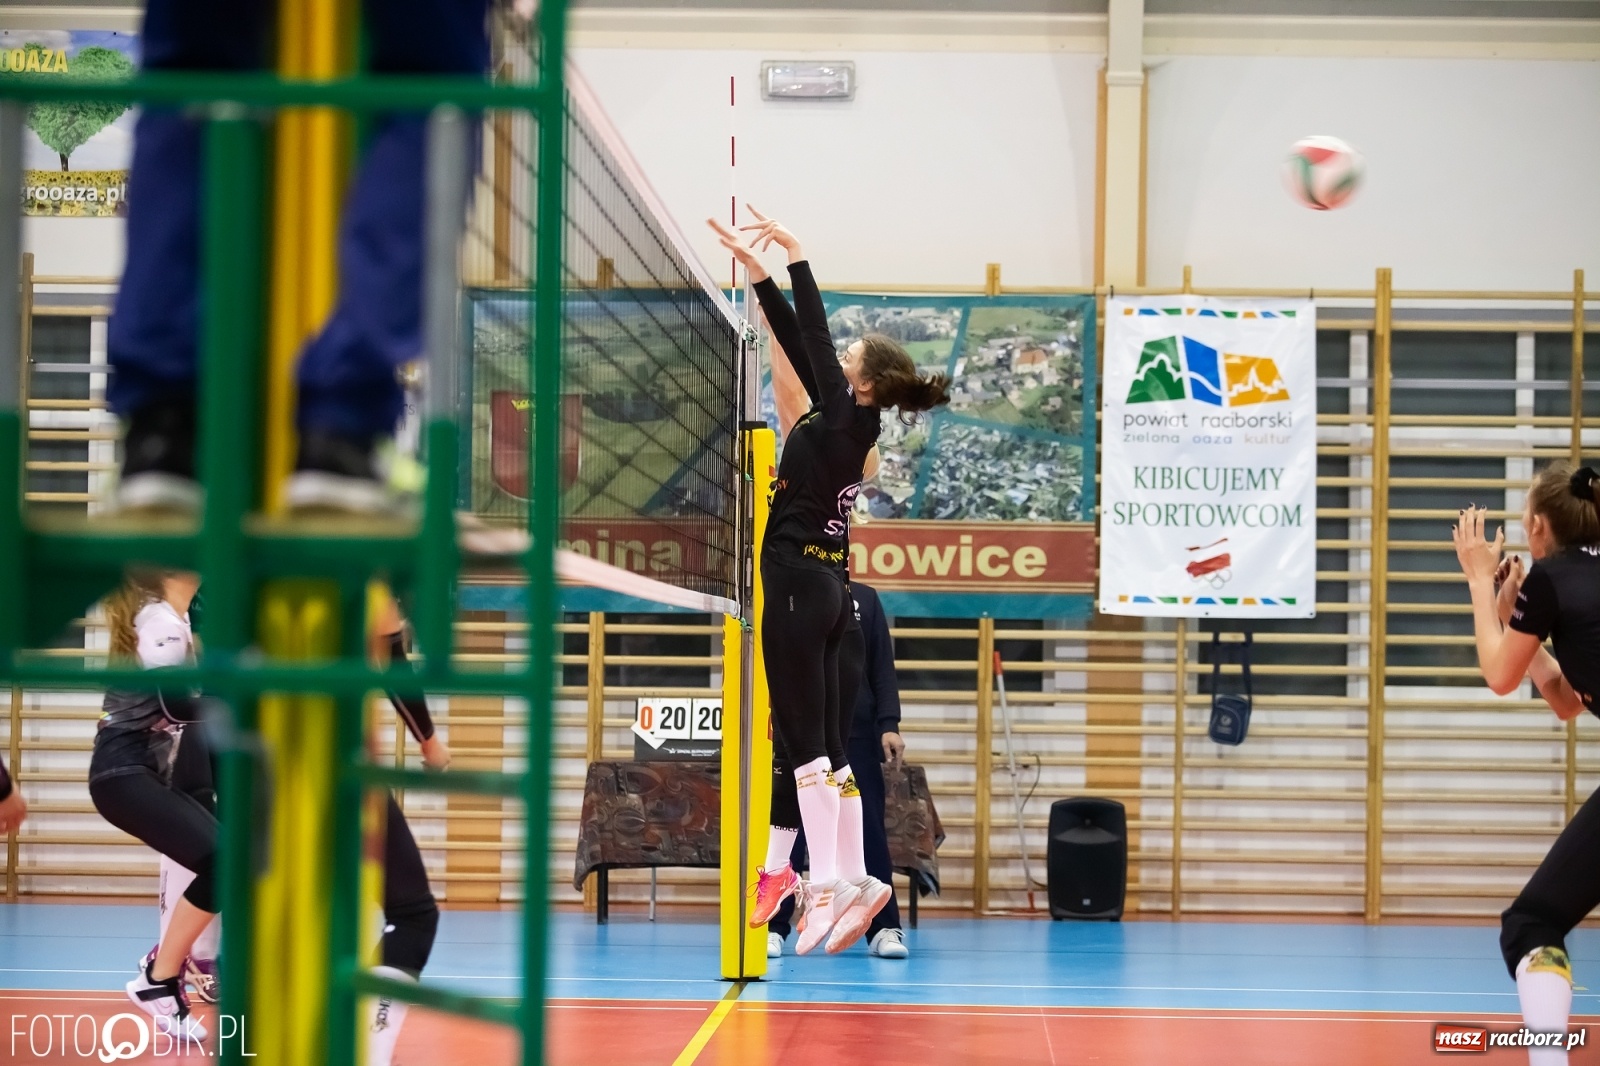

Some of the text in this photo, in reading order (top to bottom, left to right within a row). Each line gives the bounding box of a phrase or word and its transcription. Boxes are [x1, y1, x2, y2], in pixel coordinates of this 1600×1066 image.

[21, 183, 126, 206] rooaza.pl
[1123, 411, 1293, 431] powiat raciborski
[1123, 431, 1293, 445] zielona oaza kultur
[1133, 466, 1285, 496] KIBICUJEMY
[1113, 502, 1303, 528] SPORTOWCOM
[660, 706, 686, 731] 20
[698, 706, 723, 731] 20
